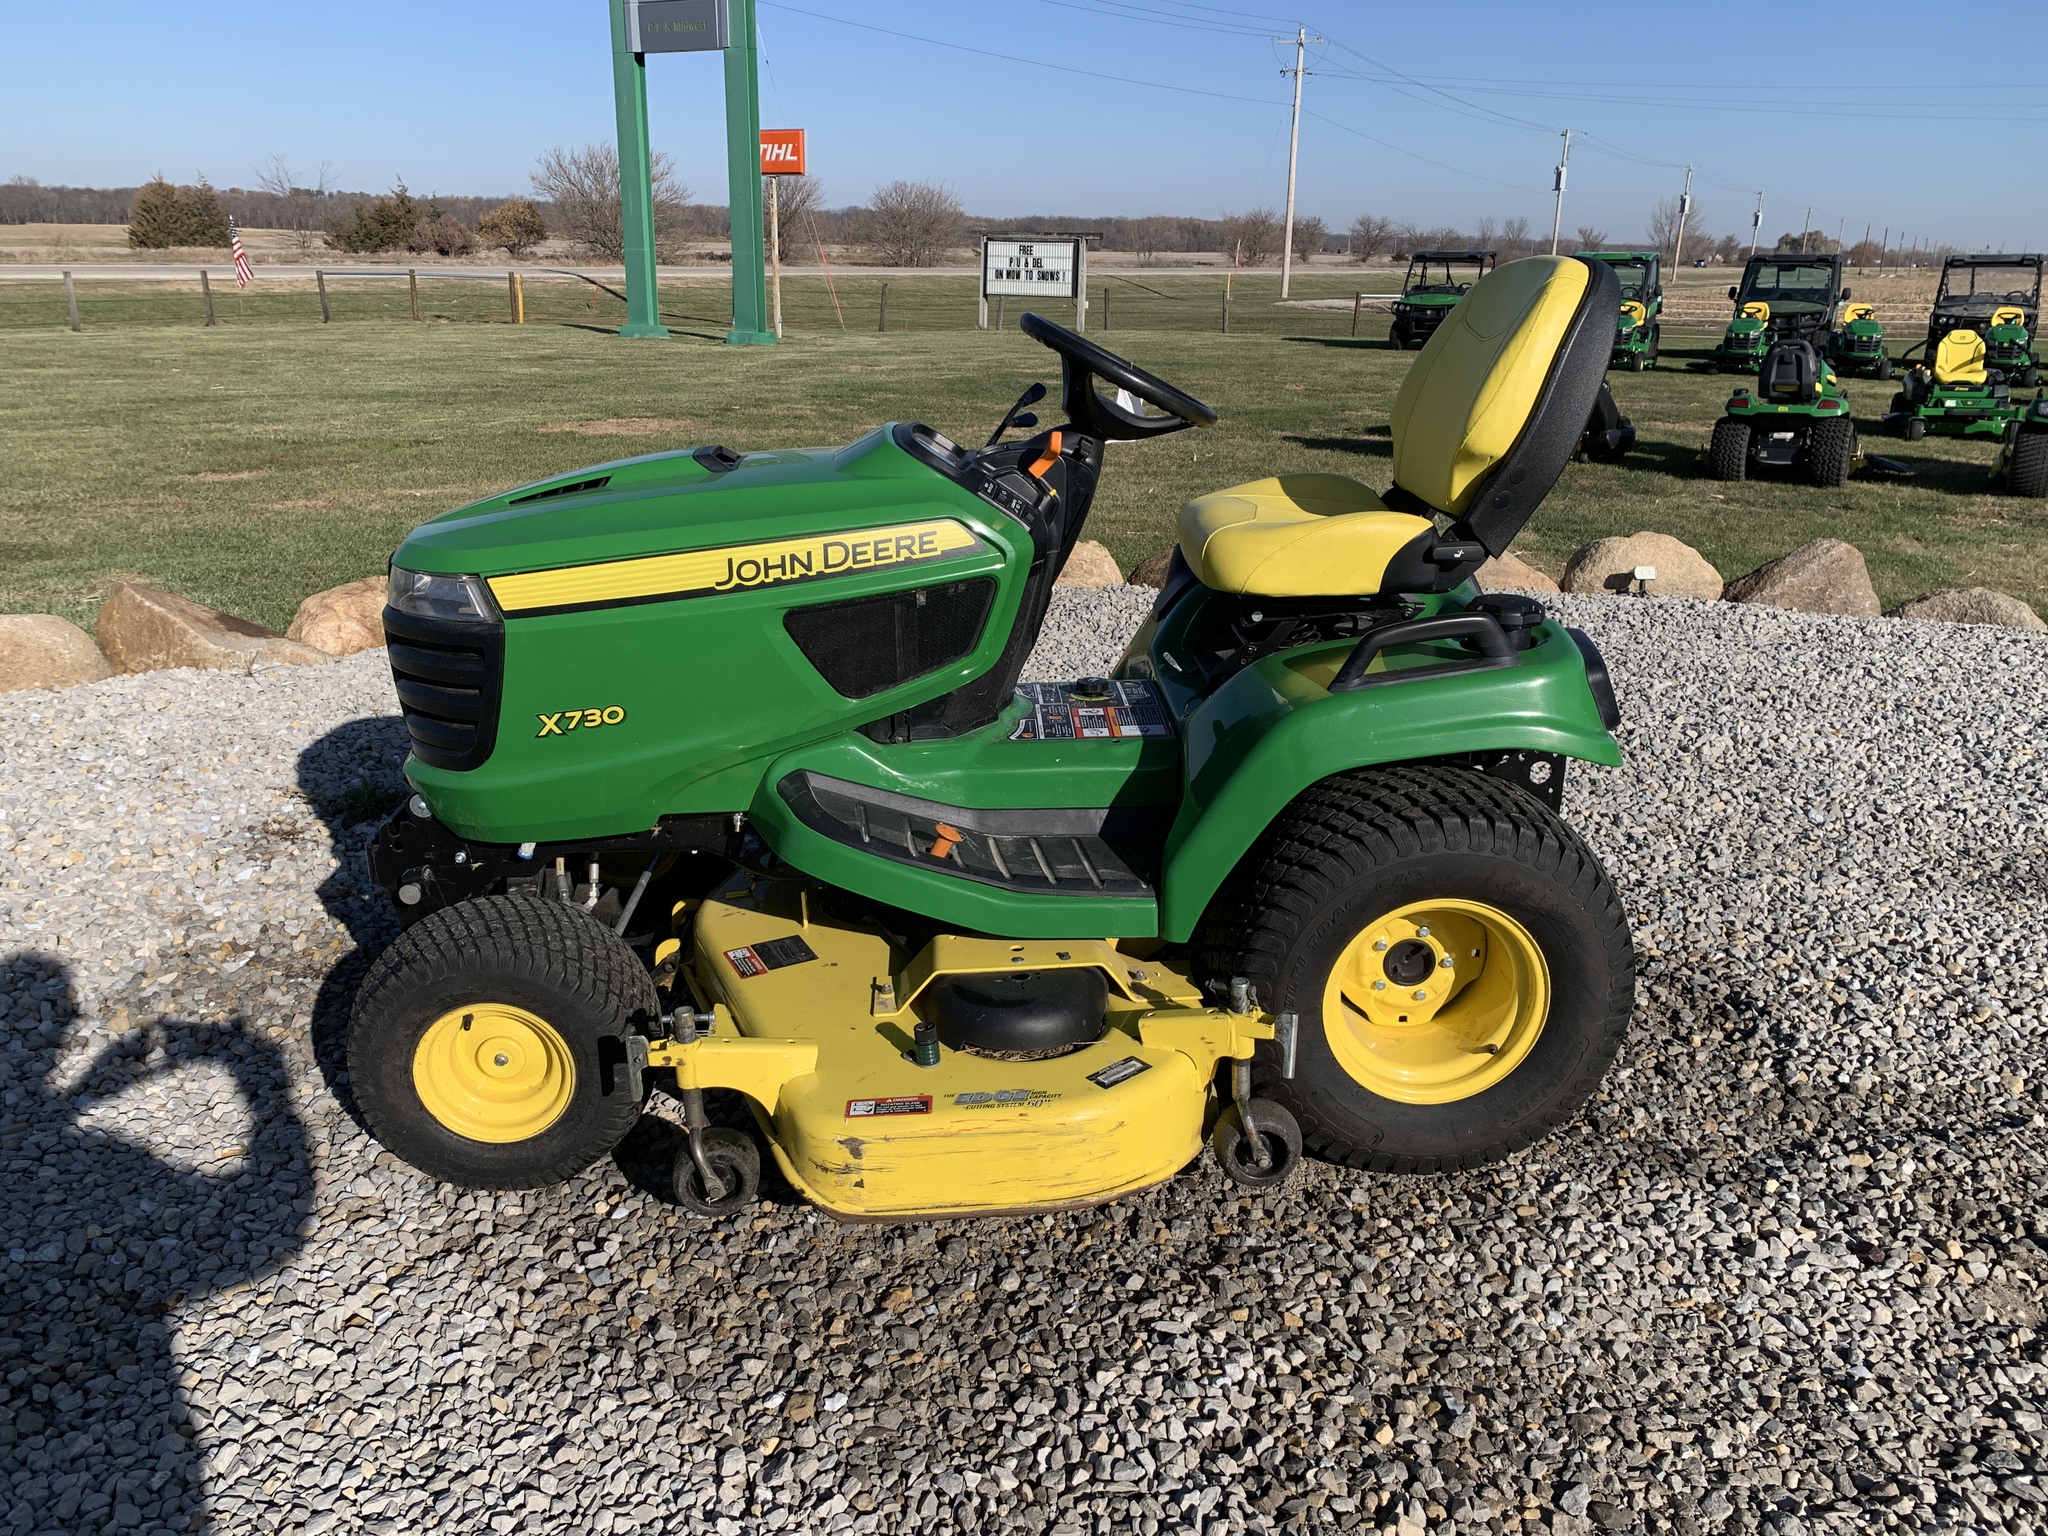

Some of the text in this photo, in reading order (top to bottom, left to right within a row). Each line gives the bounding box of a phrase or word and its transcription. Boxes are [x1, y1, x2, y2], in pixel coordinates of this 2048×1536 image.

[674, 19, 708, 32] Midwest
[760, 143, 798, 162] TIHL
[1019, 245, 1033, 255] FREE
[1024, 257, 1029, 267] &
[1033, 258, 1043, 268] DEL
[995, 269, 1003, 279] ON
[1025, 270, 1033, 280] TO
[1037, 271, 1059, 281] SNOWS
[715, 530, 939, 587] JOHN DEERE
[535, 705, 625, 737] X730
[953, 1089, 1030, 1106] EDGE
